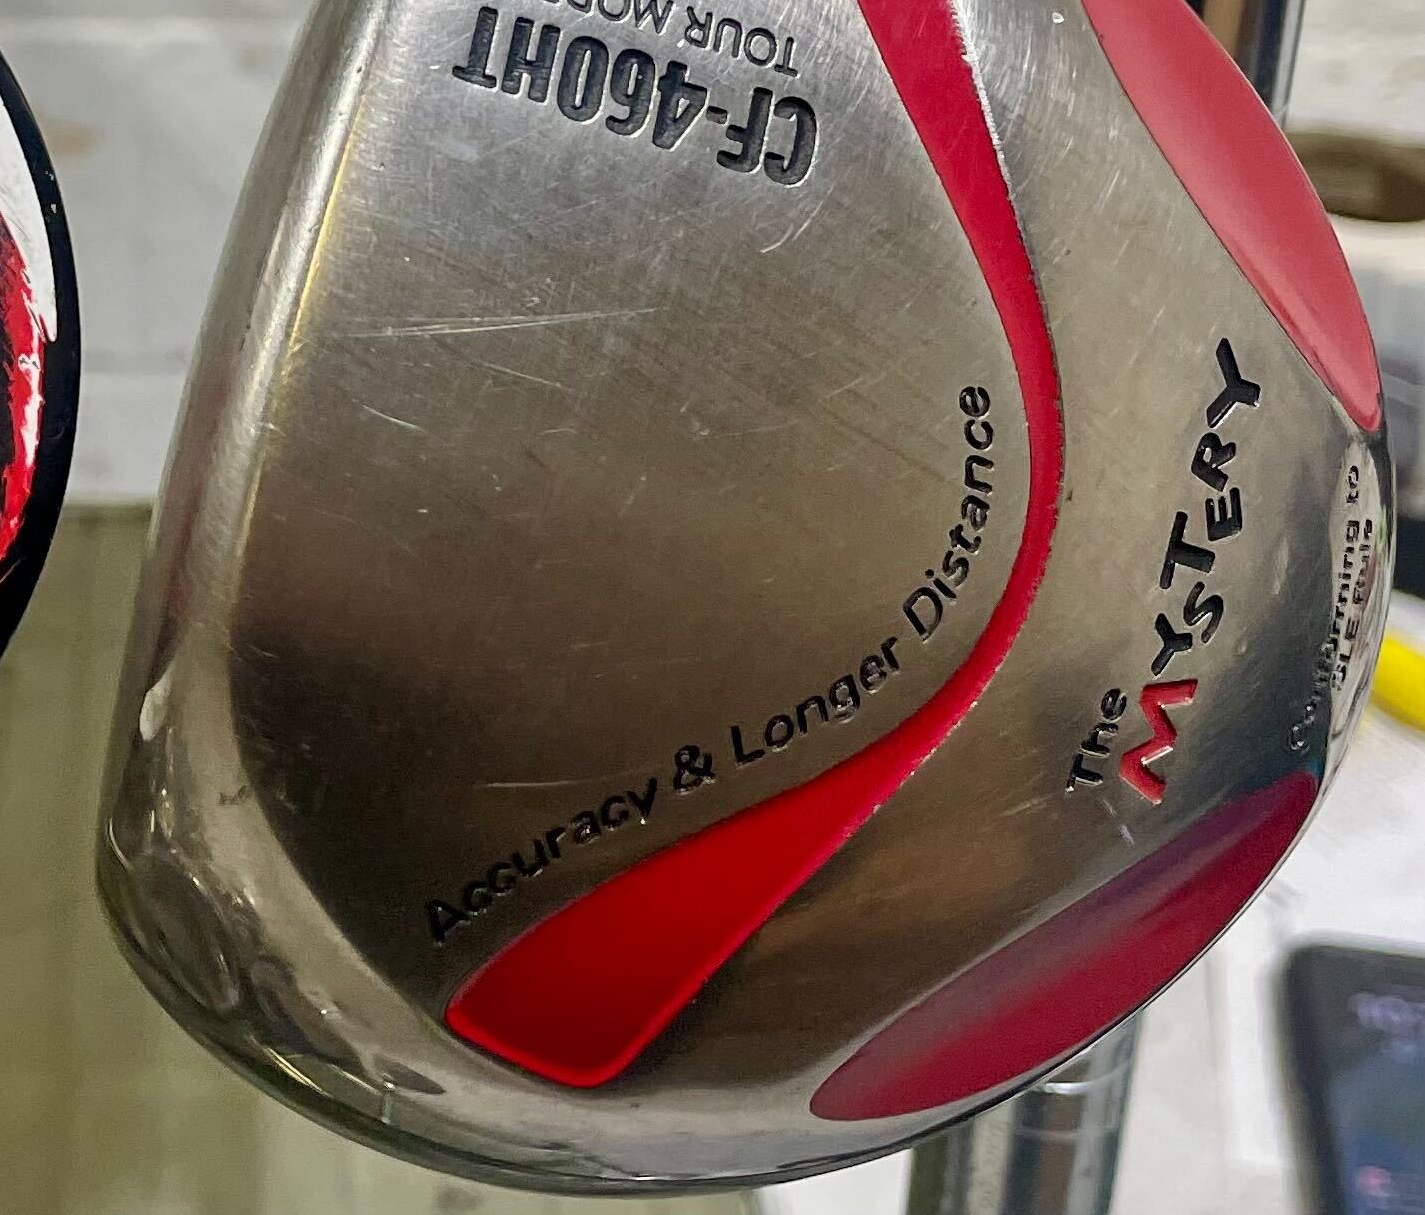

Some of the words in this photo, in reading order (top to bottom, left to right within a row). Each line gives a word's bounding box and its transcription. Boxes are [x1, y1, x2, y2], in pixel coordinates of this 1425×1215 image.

[452, 5, 820, 188] CF-460HT
[681, 5, 801, 80] TOUR
[1065, 686, 1129, 794] The
[1119, 337, 1263, 805] MYSTERY
[1345, 465, 1360, 505] to
[426, 775, 658, 945] Accuracy
[672, 742, 715, 795] &
[729, 636, 904, 768] Longer
[902, 385, 995, 645] Distance
